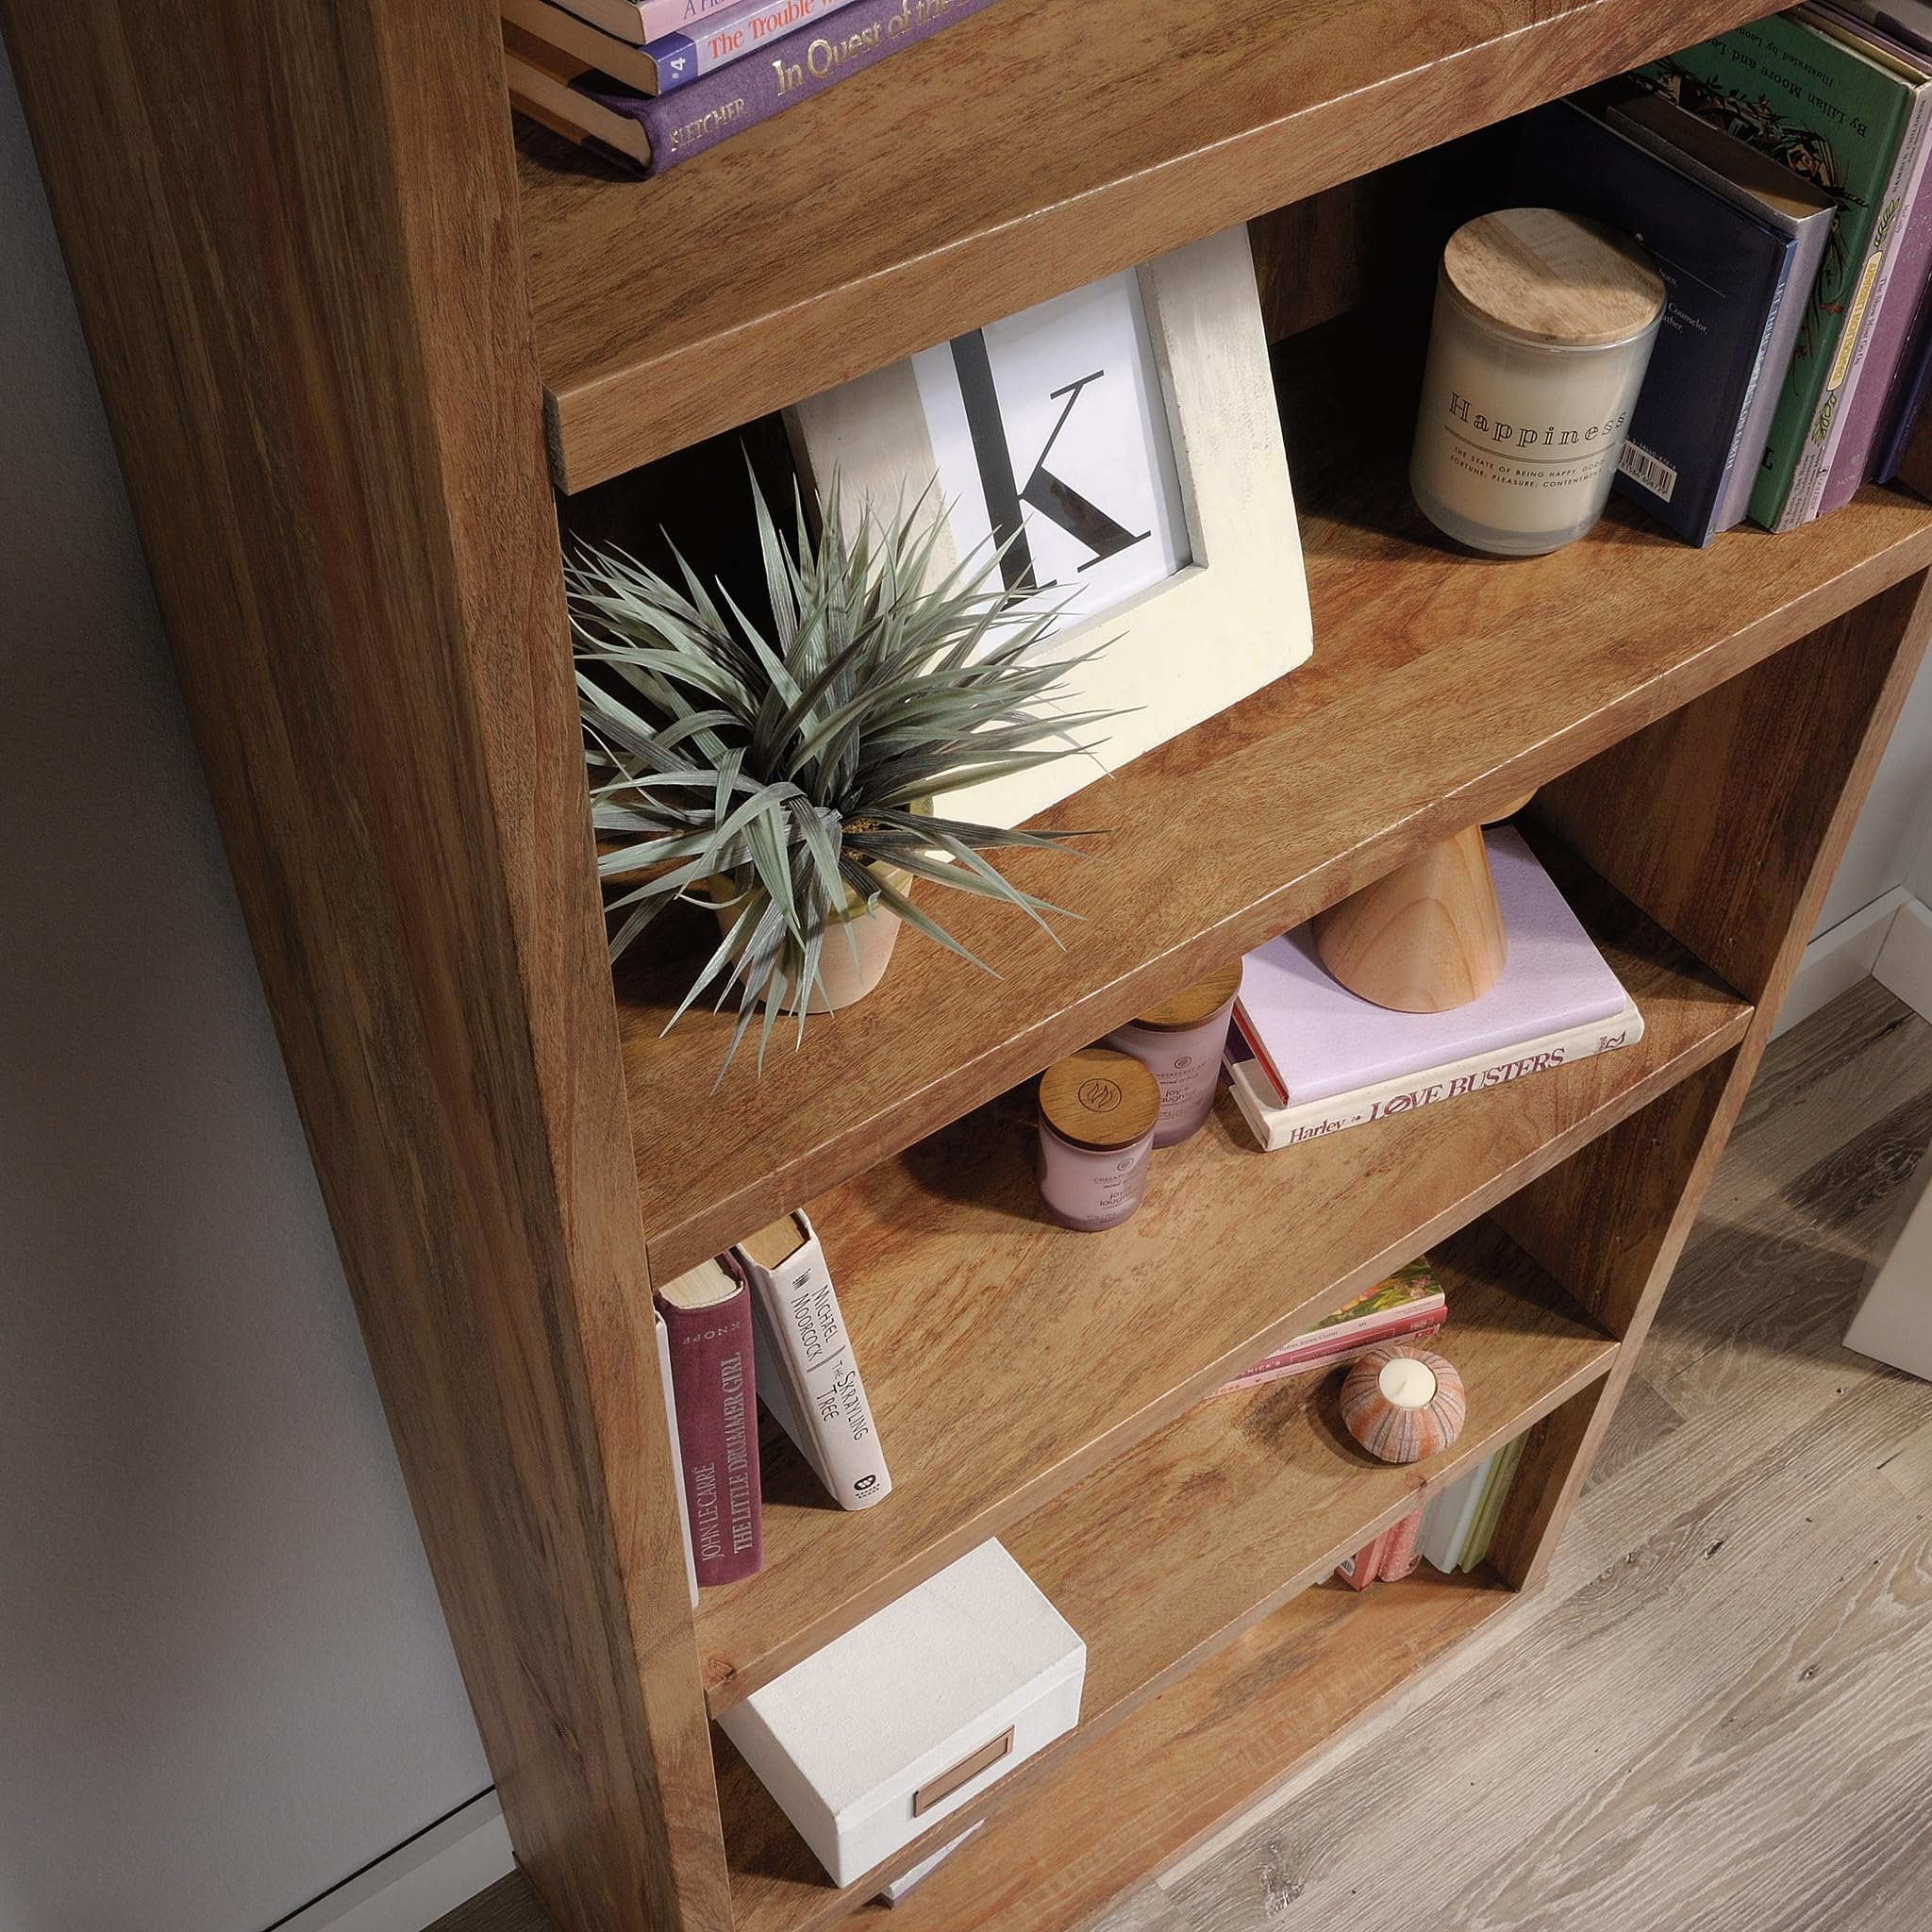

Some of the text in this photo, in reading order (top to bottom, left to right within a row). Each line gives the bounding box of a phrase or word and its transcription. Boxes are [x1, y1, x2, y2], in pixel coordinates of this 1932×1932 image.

[708, 0, 815, 61] The Trouble
[772, 58, 804, 97] In
[807, 21, 882, 79] Quest
[886, 0, 912, 40] of
[1731, 50, 1757, 70] and
[1767, 42, 1779, 57] by
[1760, 66, 1804, 99] Moore
[1782, 51, 1834, 90] Illustrated
[668, 97, 749, 153] FLETCHER
[1807, 92, 1846, 124] Lilian
[1848, 116, 1869, 138] By
[1667, 301, 1709, 336] Counselor,
[1448, 391, 1627, 449] Happiness
[1454, 445, 1467, 458] THE
[1470, 455, 1494, 470] STATE
[1498, 465, 1510, 474] OF
[1515, 469, 1544, 478] BEING
[1165, 1090, 1182, 1098] joy
[1289, 1046, 1566, 1145] Harley LOVE BUSTERS
[1109, 1191, 1125, 1200] joy
[791, 1292, 824, 1363] MOORCOCK
[811, 1284, 839, 1343] MICHAEL
[683, 1321, 741, 1345] KNOPF
[815, 1386, 841, 1423] TREE
[831, 1359, 869, 1441] THE SKRAYLING
[720, 1352, 753, 1555] THE LITTLE DRUMMER GIRL
[698, 1507, 718, 1525] LE
[700, 1525, 725, 1563] JOHN
